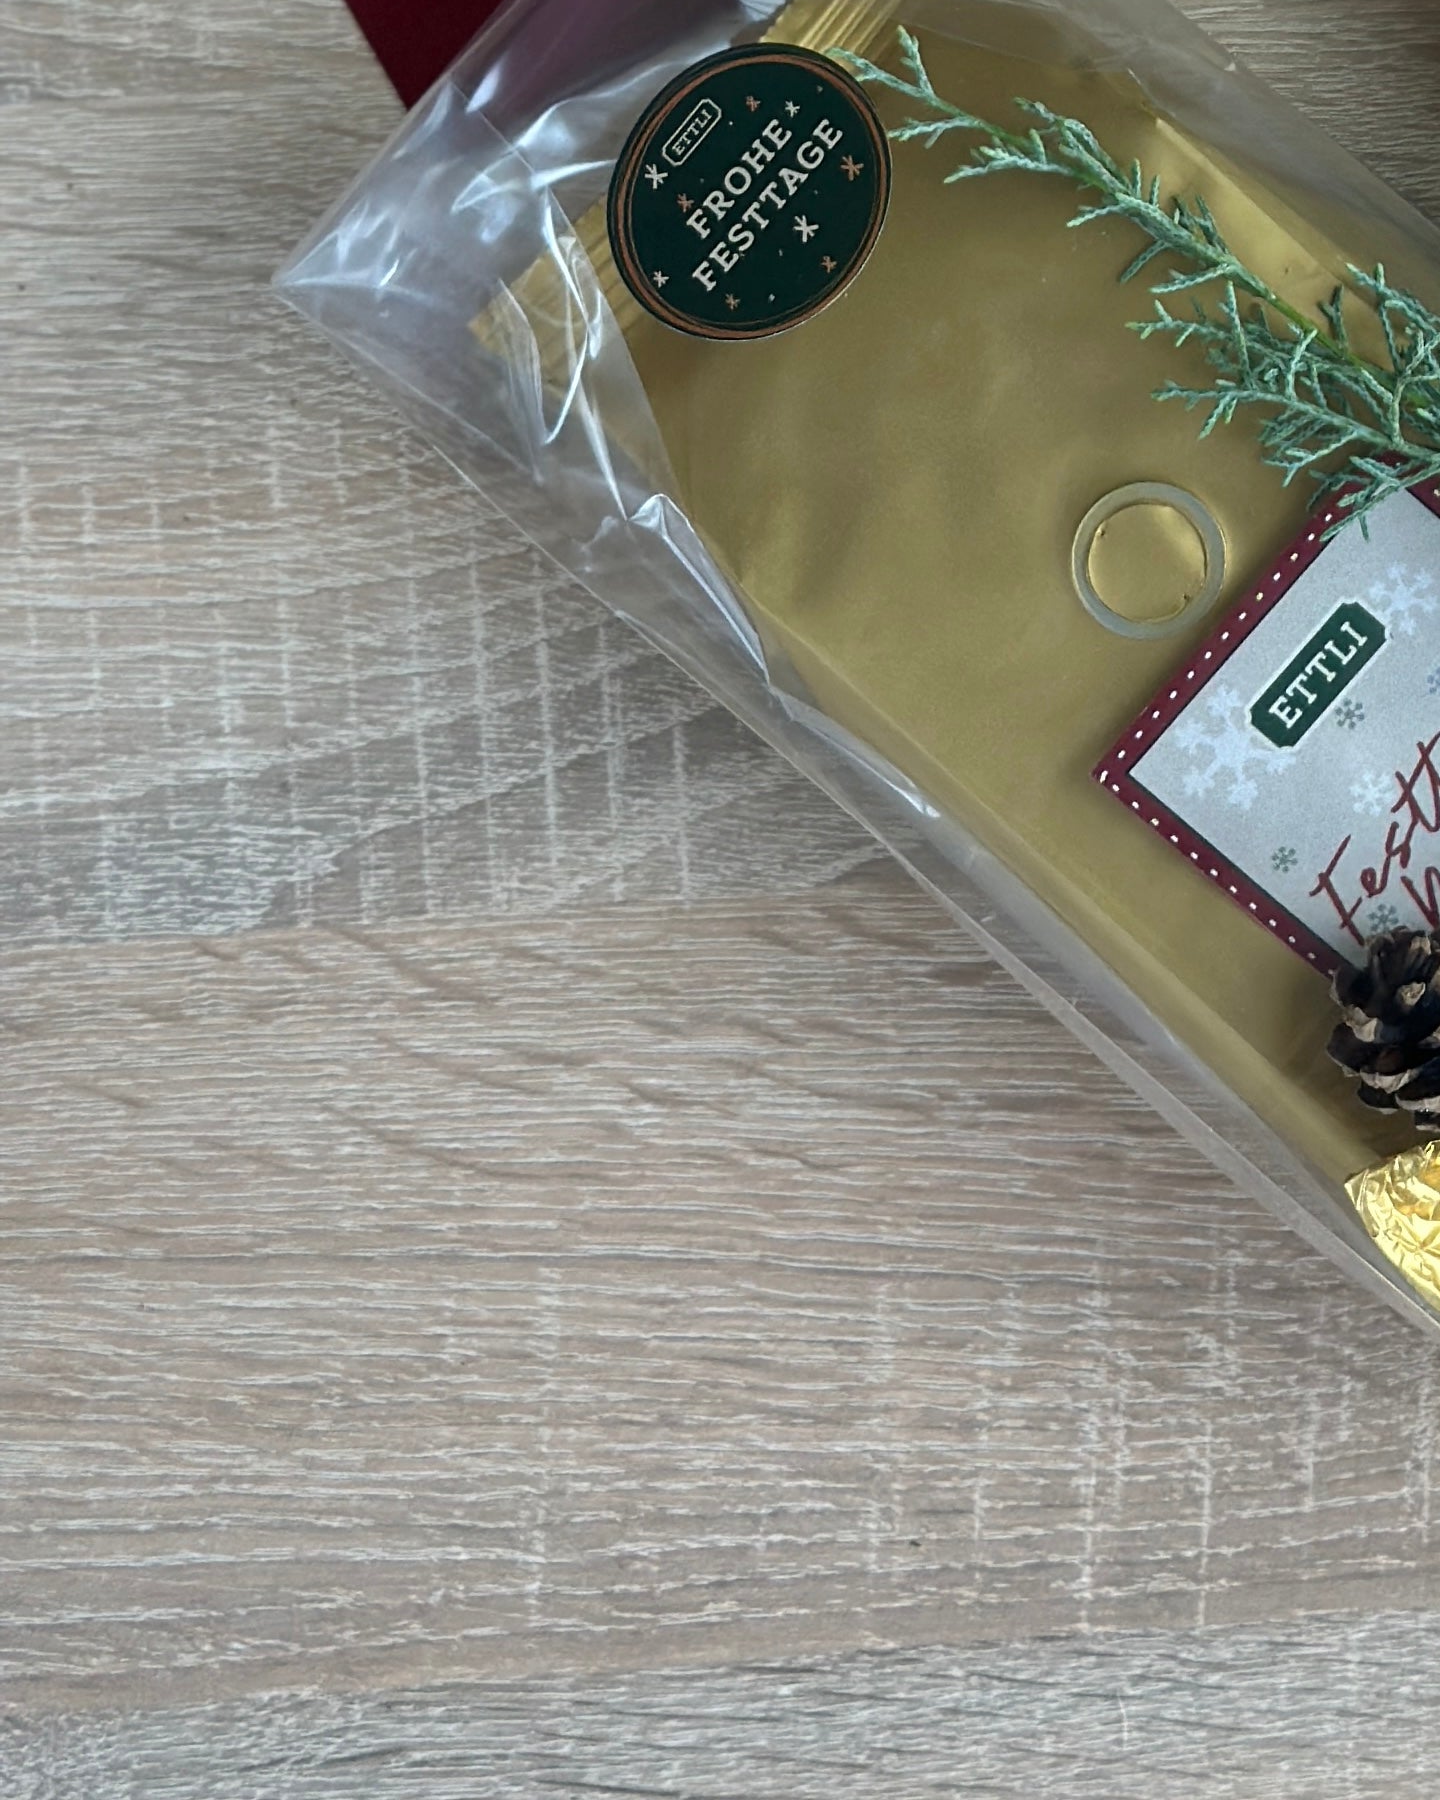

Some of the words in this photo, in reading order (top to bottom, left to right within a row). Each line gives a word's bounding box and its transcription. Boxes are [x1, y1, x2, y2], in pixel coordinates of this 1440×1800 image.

[671, 108, 712, 156] ETTLI
[686, 118, 793, 240] FROHE
[692, 118, 844, 292] FESTTAGE
[1268, 621, 1368, 729] ETTLI
